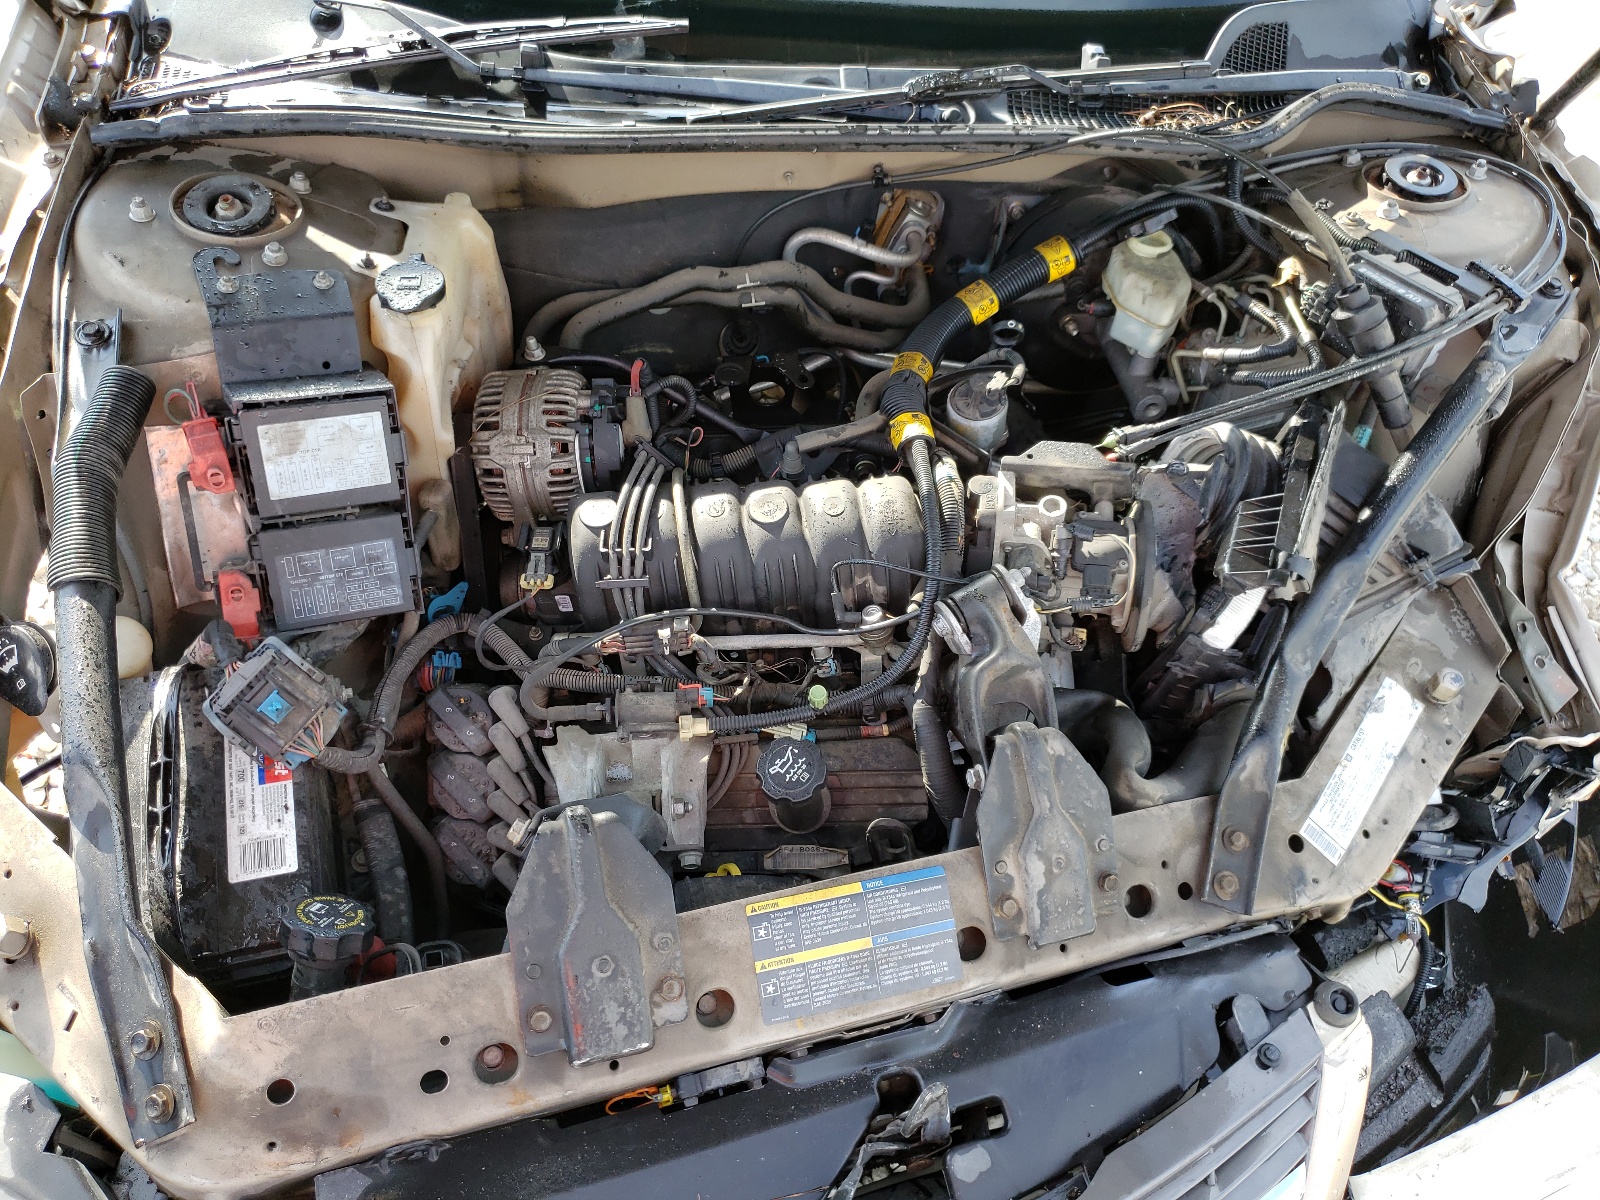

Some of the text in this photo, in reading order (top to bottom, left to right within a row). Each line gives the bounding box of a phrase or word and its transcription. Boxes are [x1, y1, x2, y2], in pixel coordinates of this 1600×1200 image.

[1350, 727, 1365, 750] CATALYST
[237, 769, 245, 782] 700
[866, 880, 884, 888] NOTICE
[758, 902, 779, 911] CAUTION
[767, 957, 794, 968] ATTENTION
